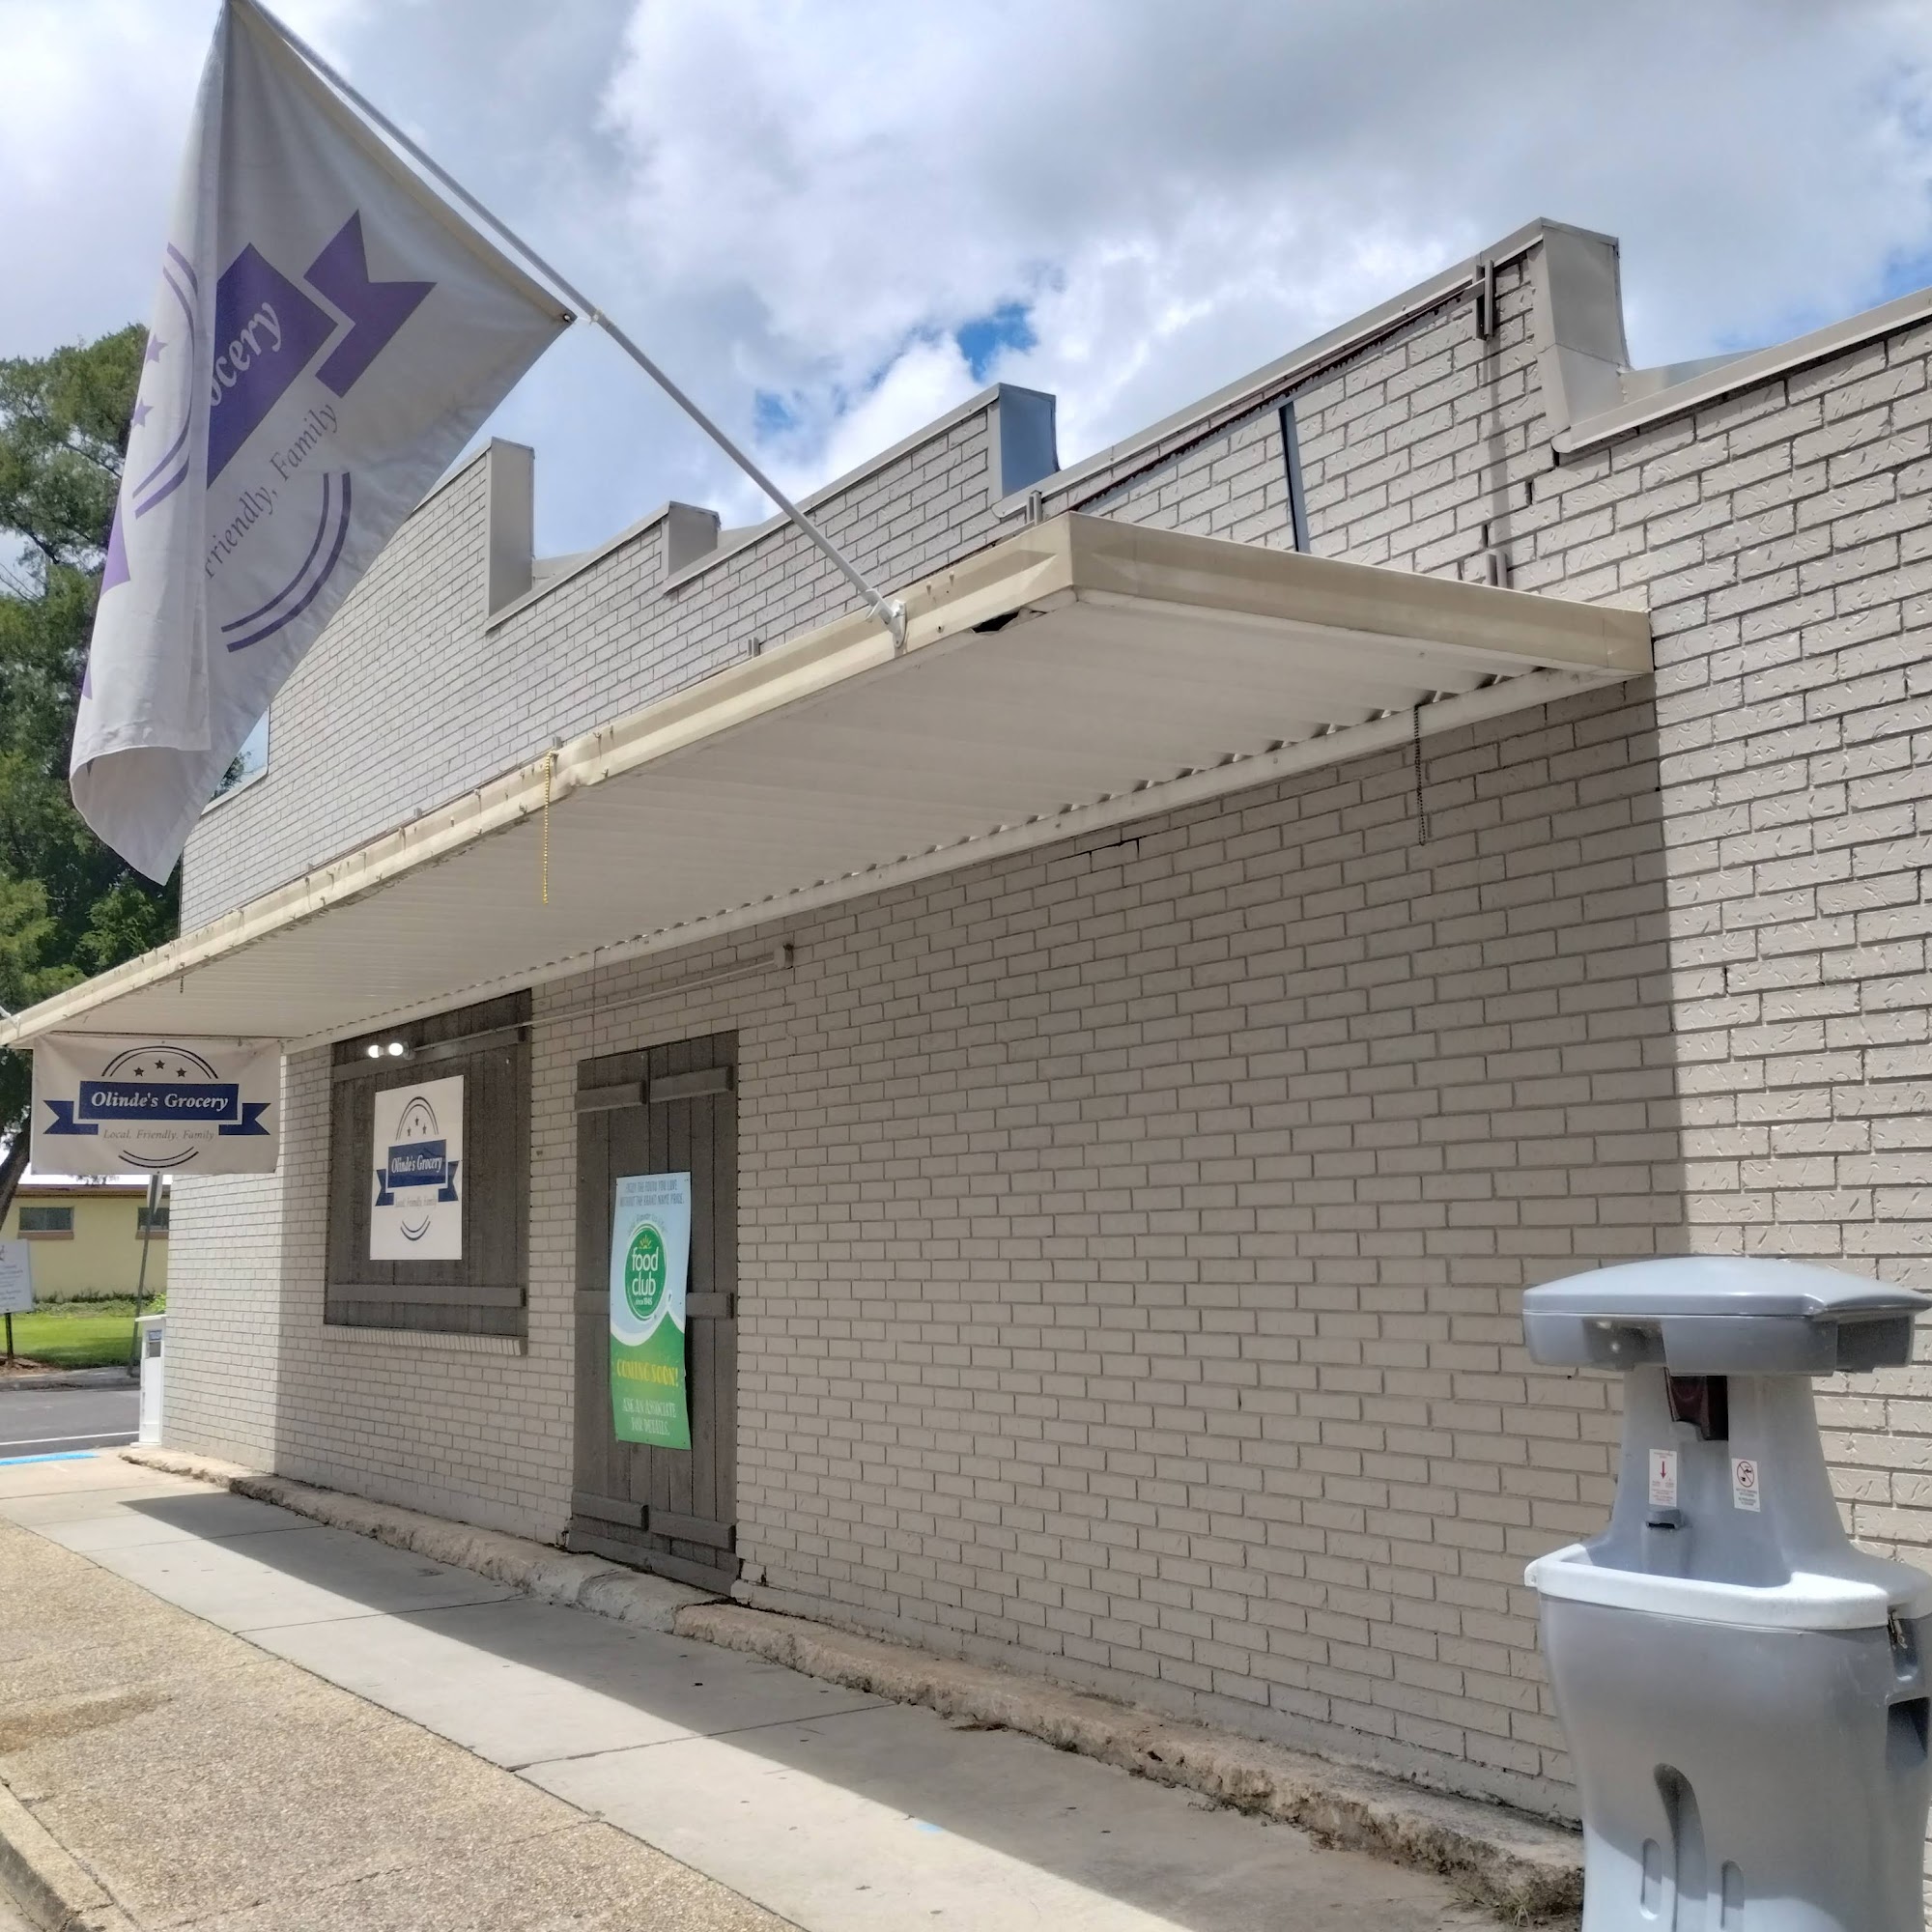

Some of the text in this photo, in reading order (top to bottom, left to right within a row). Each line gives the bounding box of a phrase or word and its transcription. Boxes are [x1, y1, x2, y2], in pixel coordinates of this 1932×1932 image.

[270, 404, 338, 482] Family
[91, 1091, 229, 1112] Olinde's Grocery
[183, 1129, 215, 1141] Family
[416, 1154, 443, 1174] Grocery
[632, 1246, 659, 1272] food
[632, 1271, 657, 1296] club
